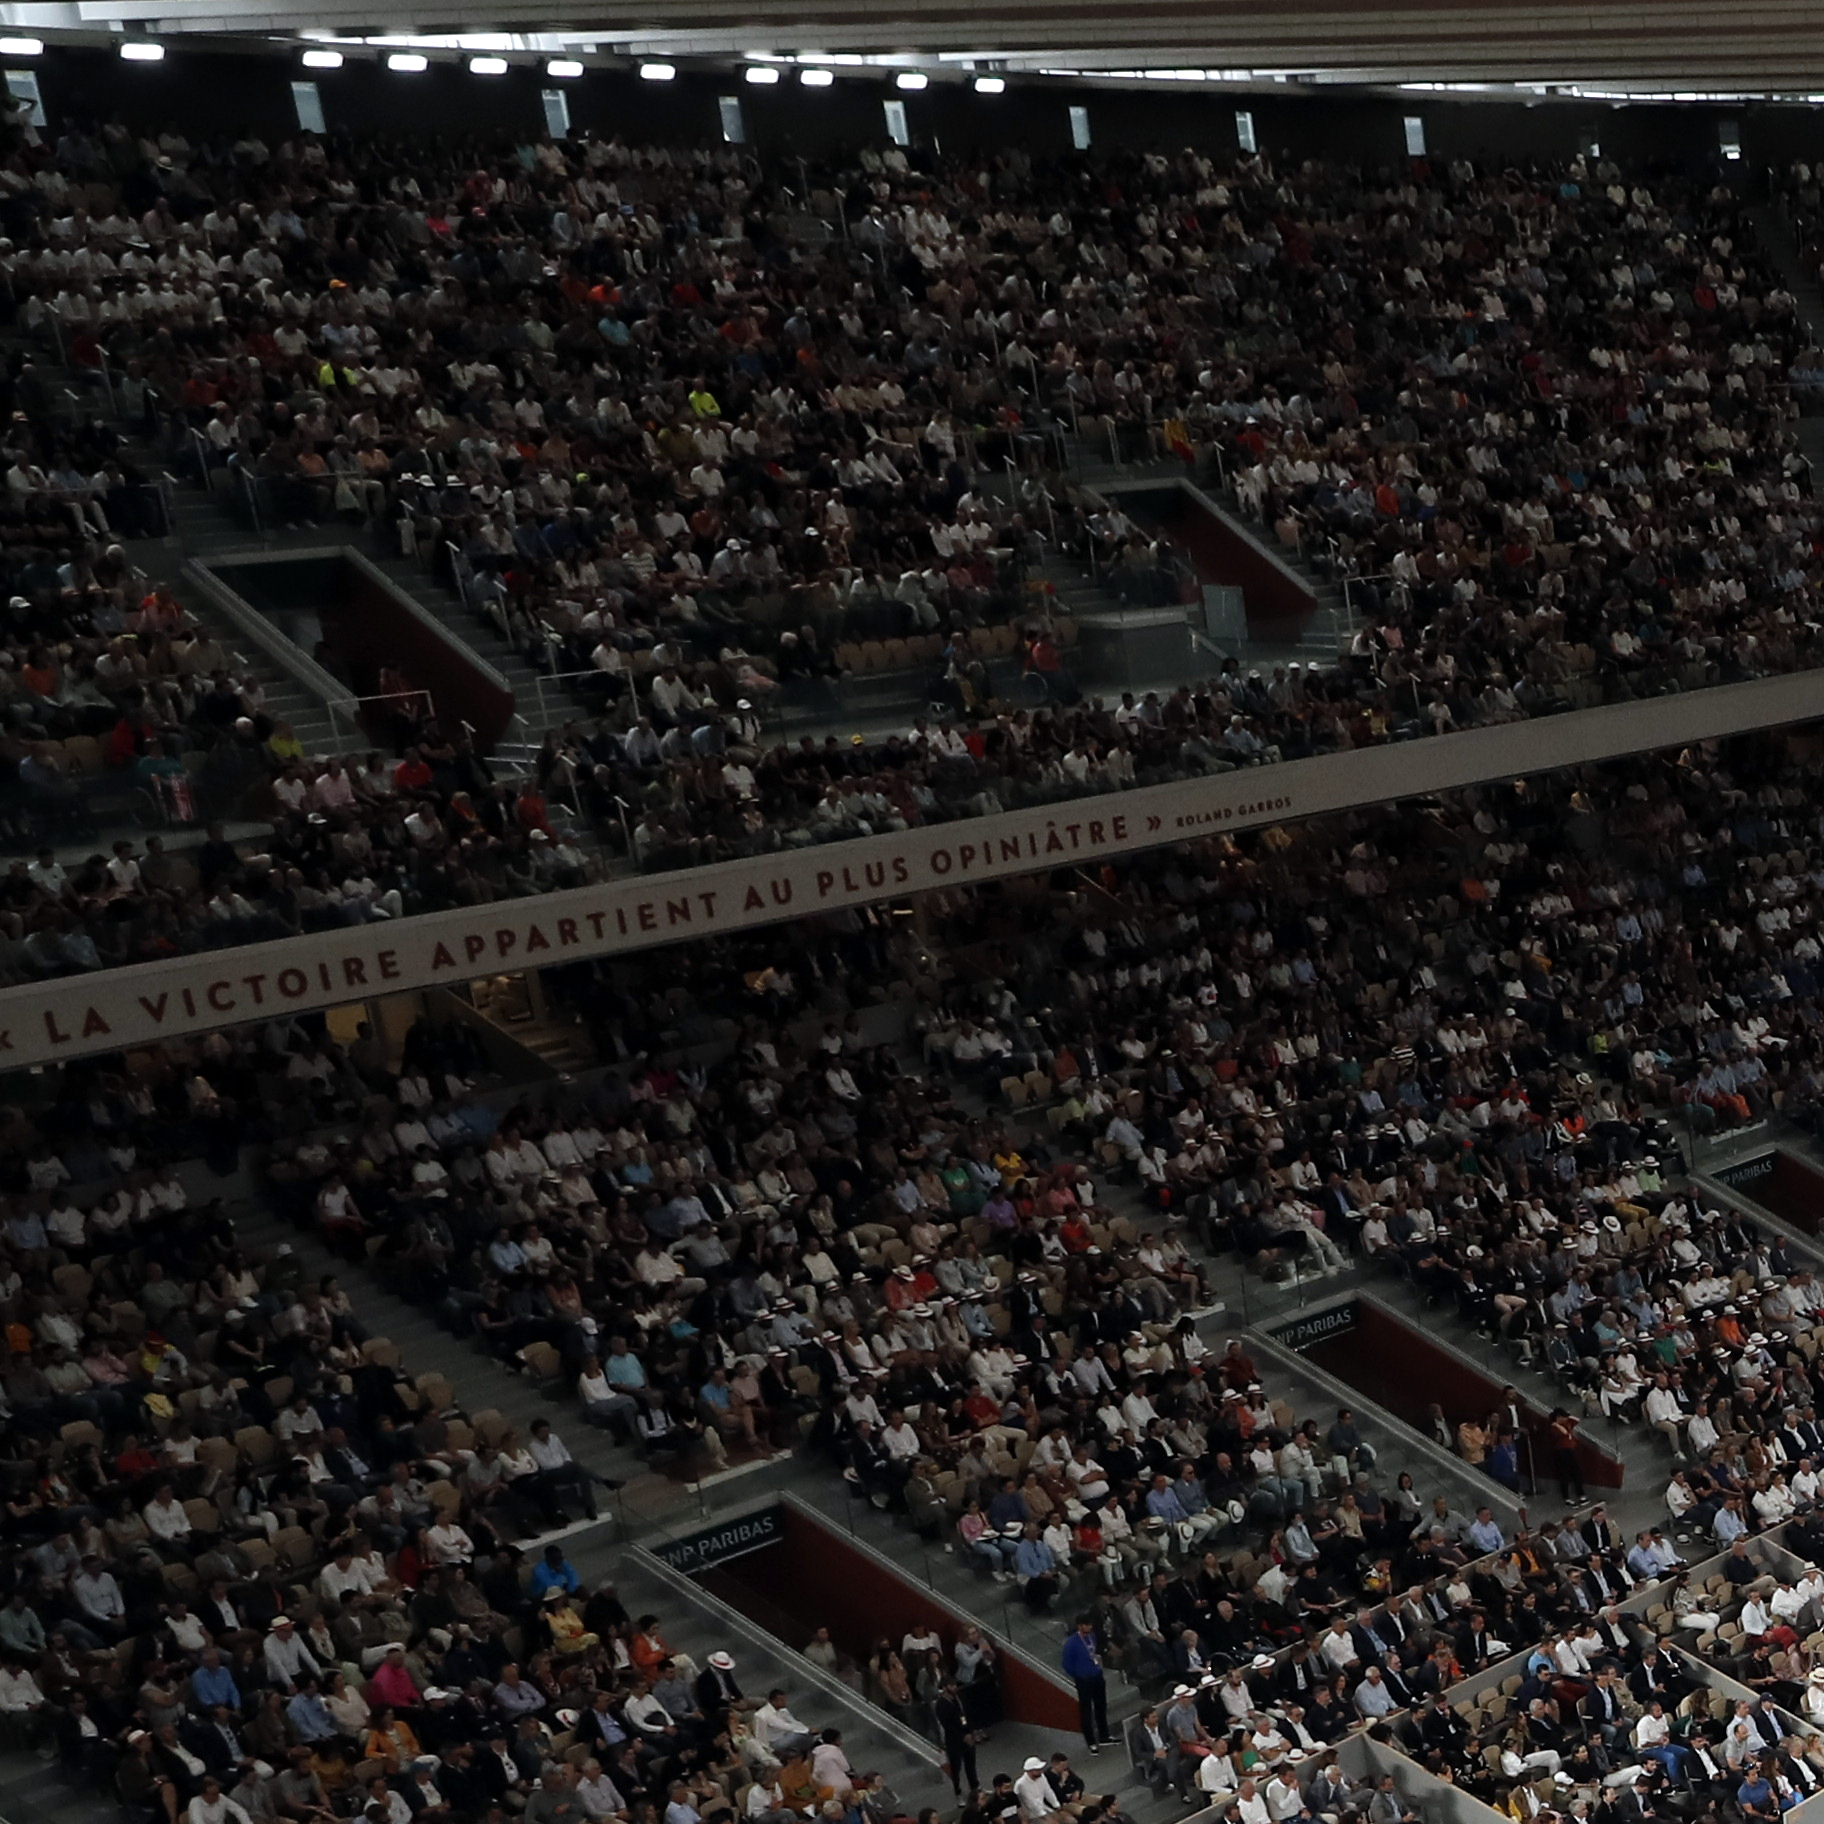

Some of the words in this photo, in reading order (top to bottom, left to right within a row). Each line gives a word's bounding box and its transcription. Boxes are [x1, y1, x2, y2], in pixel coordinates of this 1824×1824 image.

[44, 1008, 111, 1046] LA
[139, 950, 401, 1024] VICTOIRE
[431, 892, 717, 972] APPARTIENT
[743, 879, 793, 911] AU
[817, 849, 909, 898] PLUS
[930, 816, 1129, 876] OPINIÂTRE
[1176, 807, 1233, 828] ROLAND
[1237, 796, 1291, 817] GARROS
[1732, 1160, 1773, 1185] PARIBAS
[1275, 1331, 1294, 1346] NP
[1298, 1309, 1352, 1339] PARIBAS
[698, 1516, 774, 1556] PARIBAS
